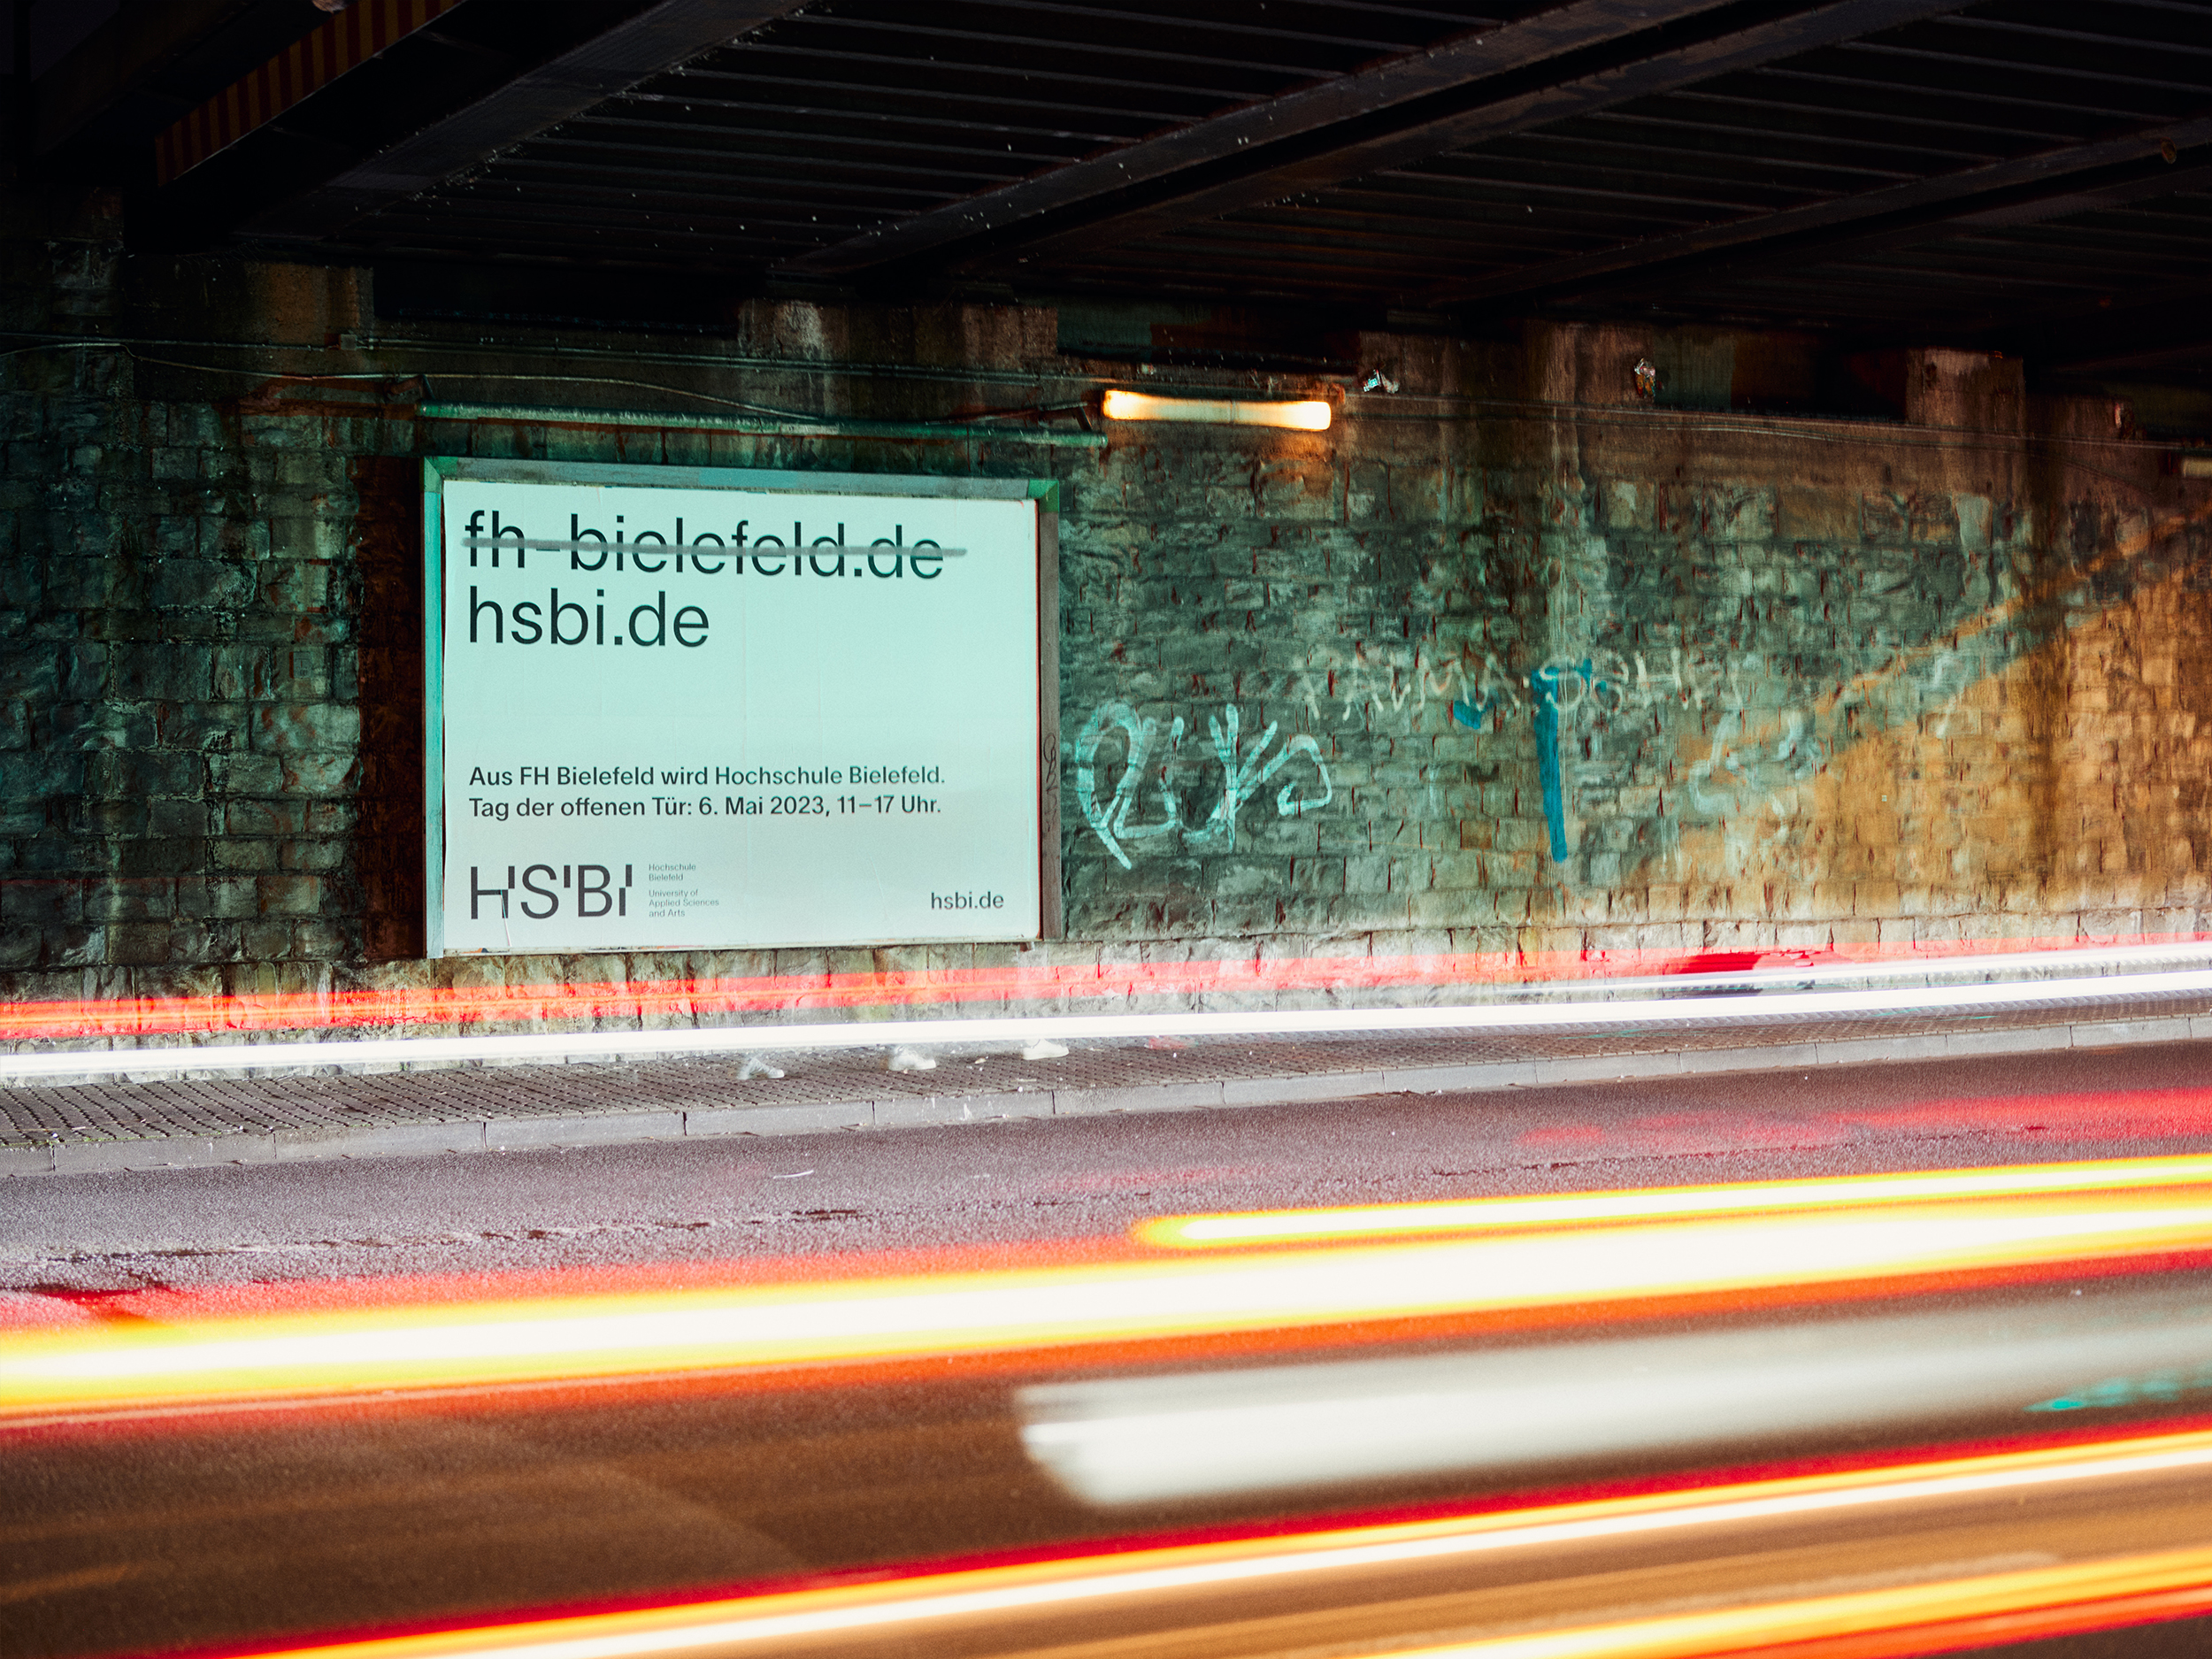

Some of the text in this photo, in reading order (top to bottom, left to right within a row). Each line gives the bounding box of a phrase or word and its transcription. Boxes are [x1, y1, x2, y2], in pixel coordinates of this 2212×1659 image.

[465, 510, 944, 580] fh-bielefeld.de
[469, 586, 710, 648] hsbi.de
[469, 765, 945, 787] Aus FH Bielefeld wird Hochschule Bielefeld.
[469, 797, 510, 822] Tag
[516, 796, 555, 817] der
[560, 796, 646, 817] offenen
[651, 796, 692, 817] Tür:
[698, 795, 718, 816] 6.
[725, 795, 764, 816] Mai
[770, 795, 831, 818] 2023,
[901, 795, 941, 814] Uhr.
[648, 898, 719, 908] Applied Sciences
[649, 889, 688, 898] University
[931, 891, 1004, 910] hsbi.de
